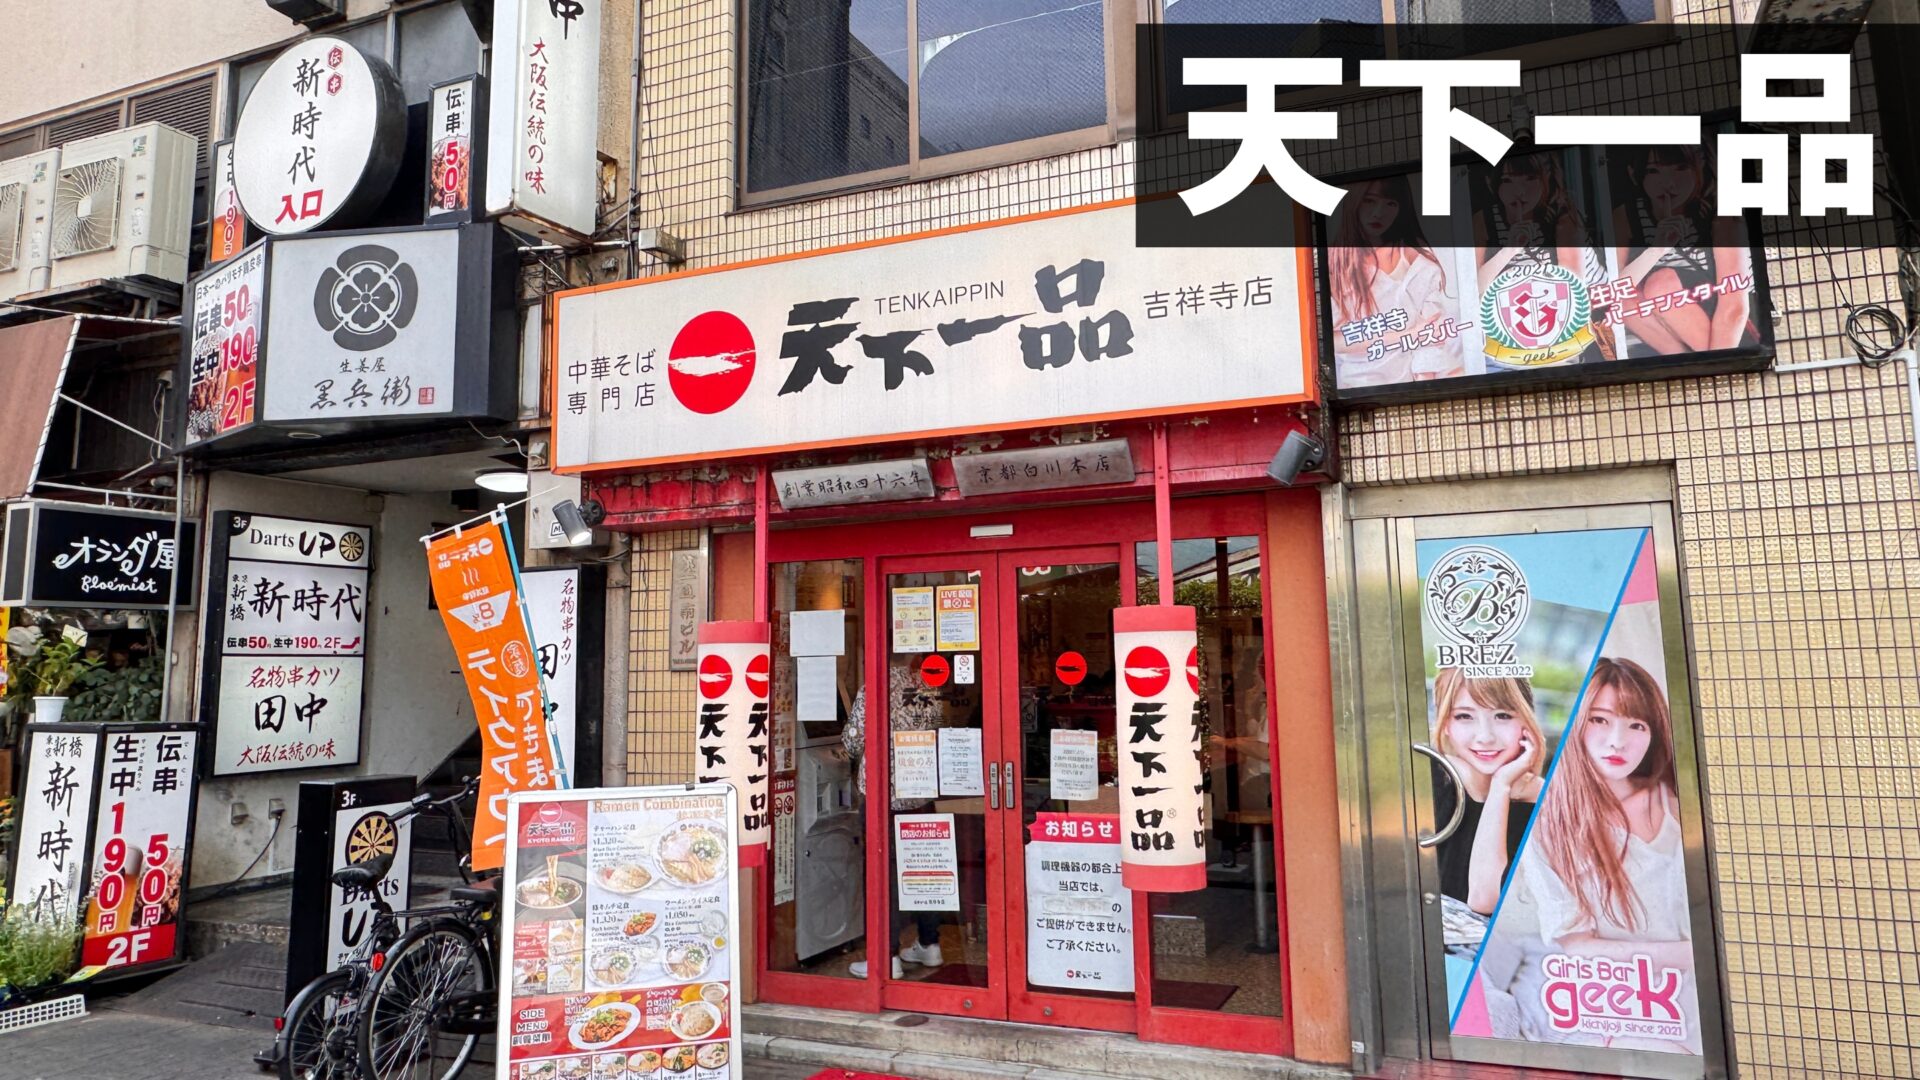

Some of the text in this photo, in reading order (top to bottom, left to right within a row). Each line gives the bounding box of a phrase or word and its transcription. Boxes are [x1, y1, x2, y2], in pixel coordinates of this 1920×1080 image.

[287, 58, 324, 187] 新時代
[446, 88, 461, 133] 伝串
[524, 37, 550, 195] 大阪伝統の味
[444, 141, 458, 209] 50円
[275, 189, 324, 224] 入口
[1512, 264, 1549, 280] 2021
[874, 280, 1005, 316] TENKAIPPIN
[1143, 275, 1273, 320] 吉祥寺店
[1589, 275, 1638, 310] 生足
[1603, 272, 1753, 328] バーテンスタイル
[195, 303, 222, 339] 伝串
[777, 258, 1134, 397] 天下一品
[1341, 308, 1408, 347] 吉祥寺
[1366, 319, 1474, 362] ガールズバー
[1521, 348, 1558, 365] geek
[192, 350, 220, 384] 生中
[339, 357, 386, 373] 生姜屋
[568, 348, 657, 385] 中華そば
[222, 378, 256, 431] 2F
[567, 382, 656, 415] 専門店
[783, 470, 926, 499] 創業昭和四十六年
[978, 454, 1111, 484] 京都白川本店
[233, 516, 247, 529] 3F
[52, 531, 177, 575] オランダ屋
[250, 528, 336, 558] Darts UP
[230, 584, 247, 621] 新橋
[248, 577, 362, 623] 新時代
[941, 590, 957, 599] LIVE
[560, 578, 575, 667] 名物串カツ
[324, 637, 341, 648] 2F
[1437, 644, 1517, 666] BREZ
[246, 664, 341, 690] 名物串カツ
[1465, 666, 1532, 677] SINCE 2022
[254, 692, 328, 735] 田中
[53, 736, 83, 759] 新橋
[152, 734, 183, 795] 伝串
[236, 739, 337, 767] 大阪伝統の味
[110, 734, 140, 797] 生中
[1129, 702, 1175, 852] 天下一品
[341, 790, 357, 808] 3F
[593, 795, 724, 814] Ramen Combination
[35, 761, 80, 925] 新時代
[1046, 820, 1113, 838] お知らせ
[96, 801, 128, 934] 190円
[140, 832, 170, 927] 50円
[1041, 860, 1121, 874] 調理機器の都合上
[1059, 880, 1104, 893] 当店では、
[1112, 903, 1122, 913] の
[1036, 918, 1131, 934] ご提供ができません。
[106, 932, 151, 966] 2F
[1046, 938, 1121, 954] ご了承ください。
[1546, 958, 1635, 982] Girls Bar
[1545, 959, 1681, 1029] geek
[517, 1022, 547, 1032] MENU
[521, 1009, 545, 1019] SIDE
[1581, 1019, 1682, 1036] kichijoji since 2021
